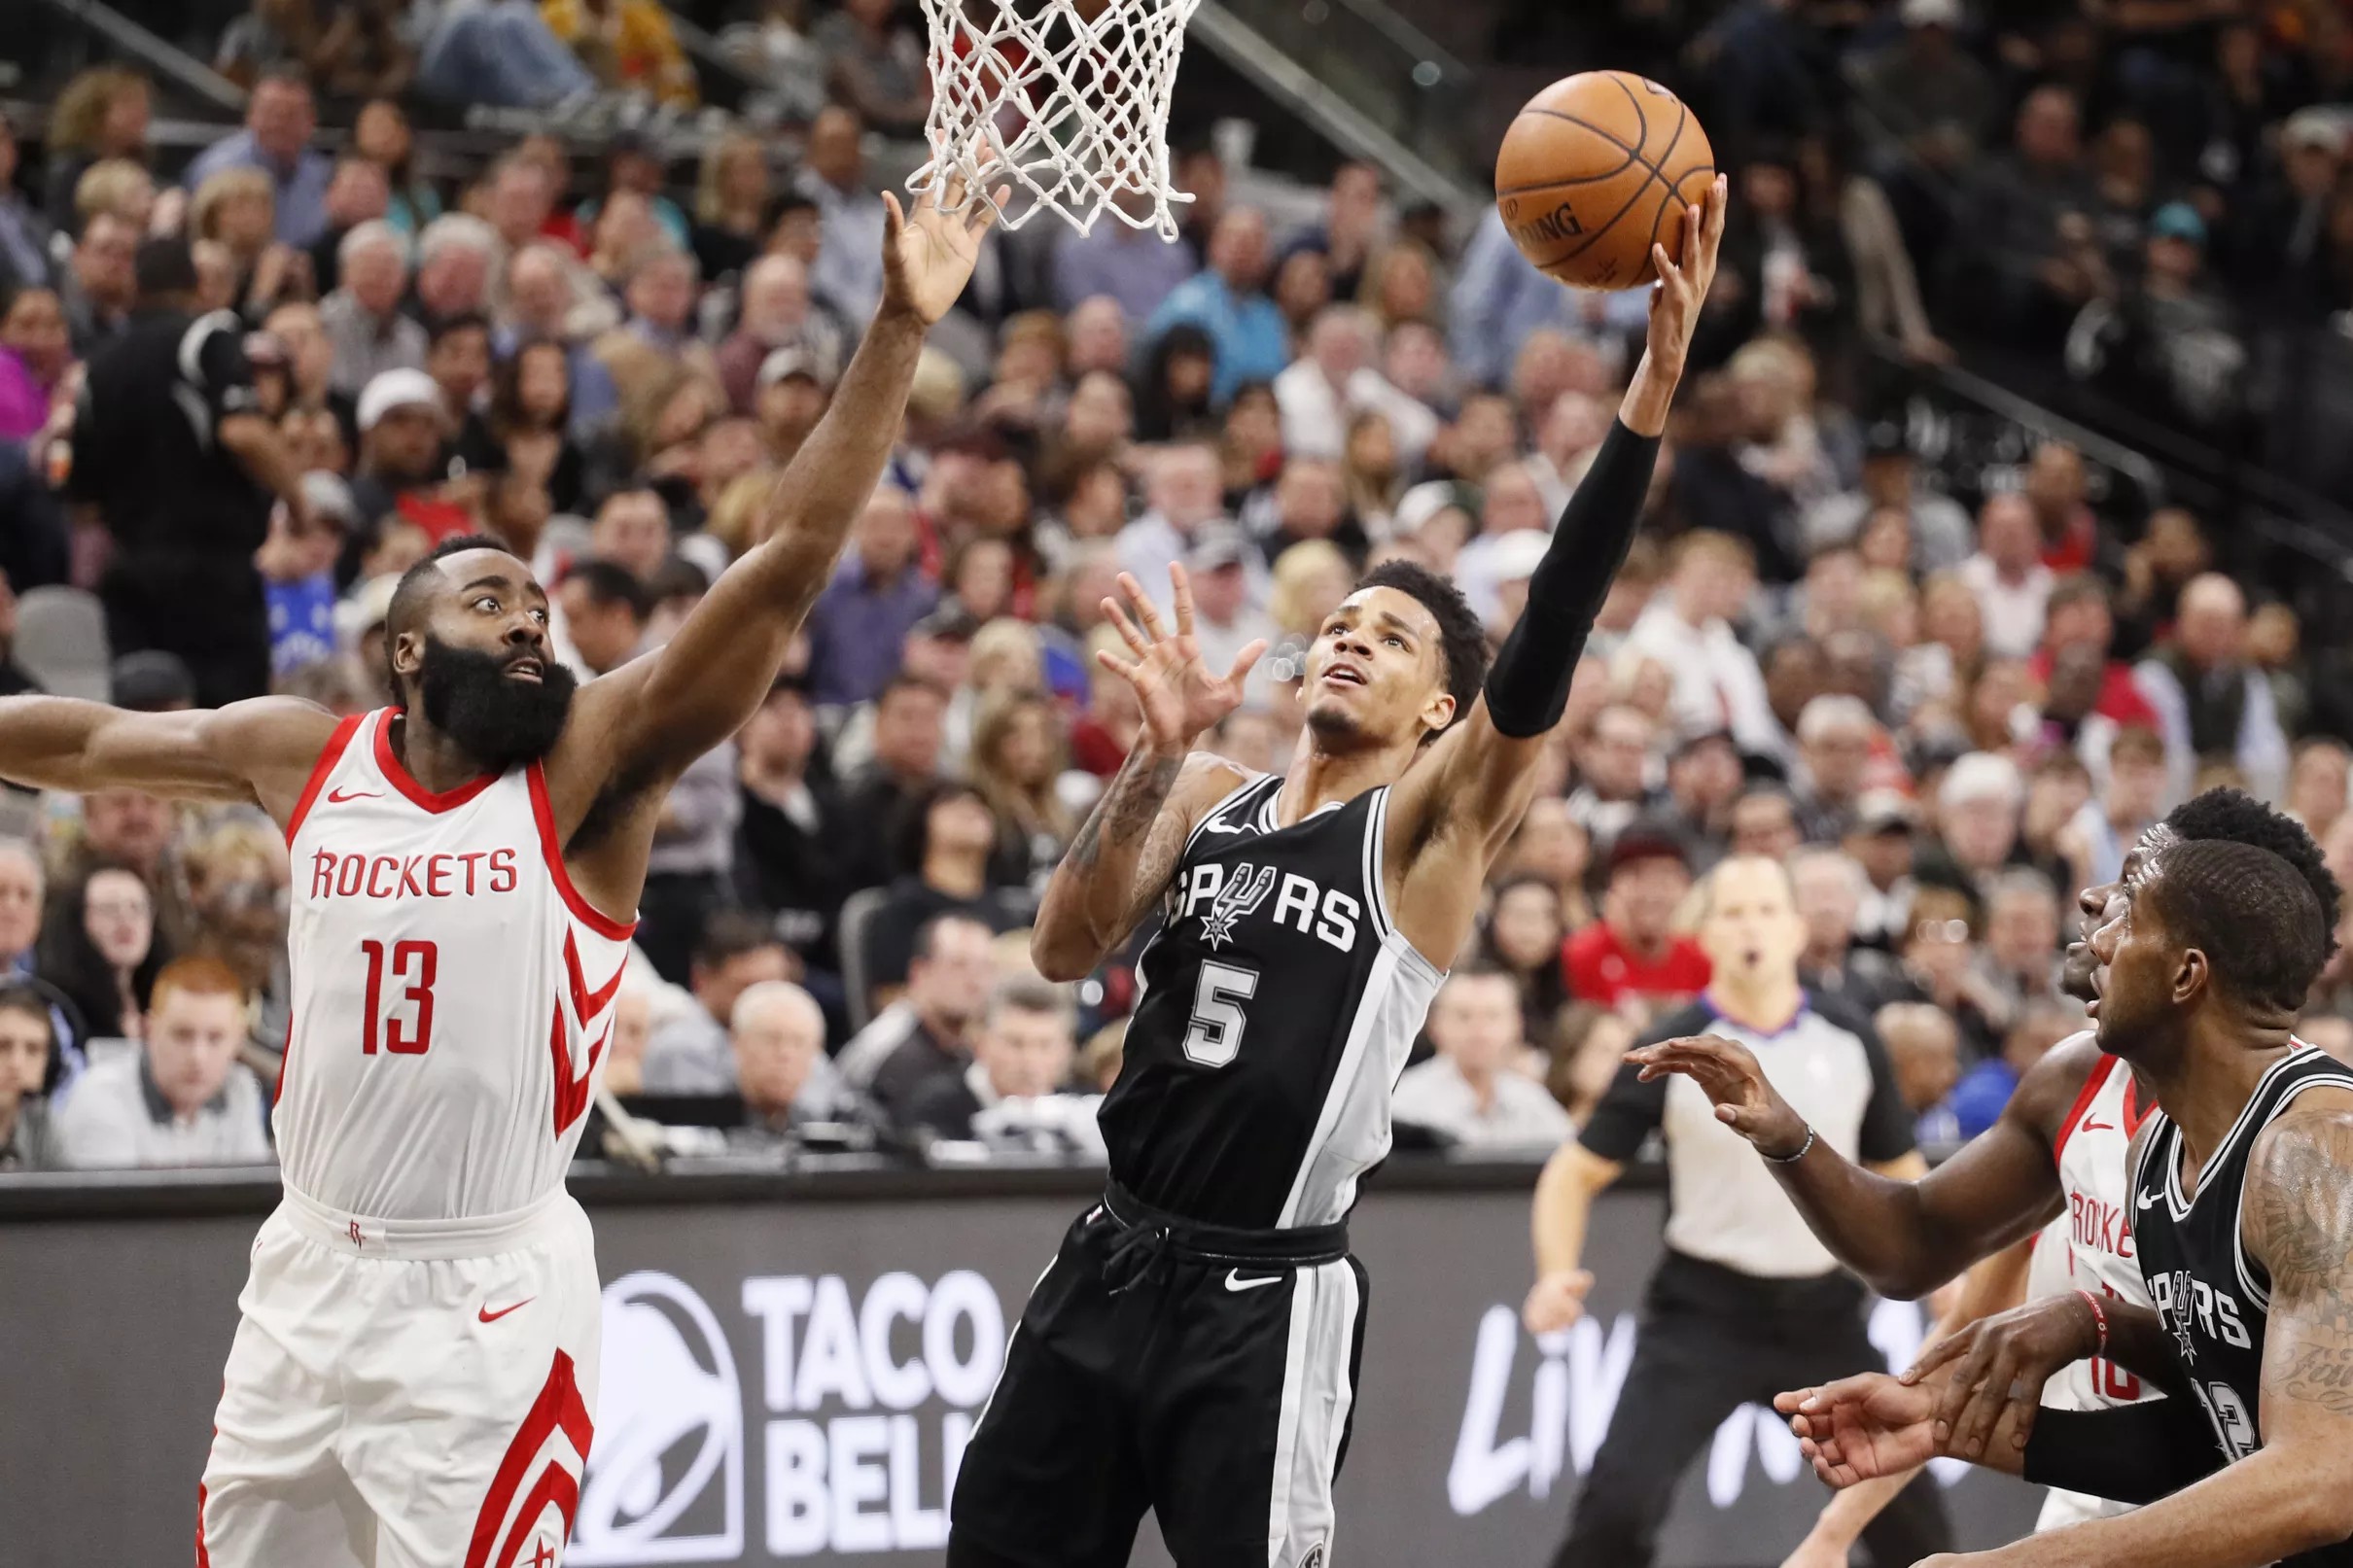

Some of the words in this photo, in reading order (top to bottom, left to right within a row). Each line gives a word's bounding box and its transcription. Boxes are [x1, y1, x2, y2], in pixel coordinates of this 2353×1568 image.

[310, 846, 517, 900] ROCKETS
[1169, 861, 1360, 954] SPURS
[362, 939, 438, 1055] 13
[1182, 958, 1260, 1068] 5
[741, 1270, 1007, 1411] TACO
